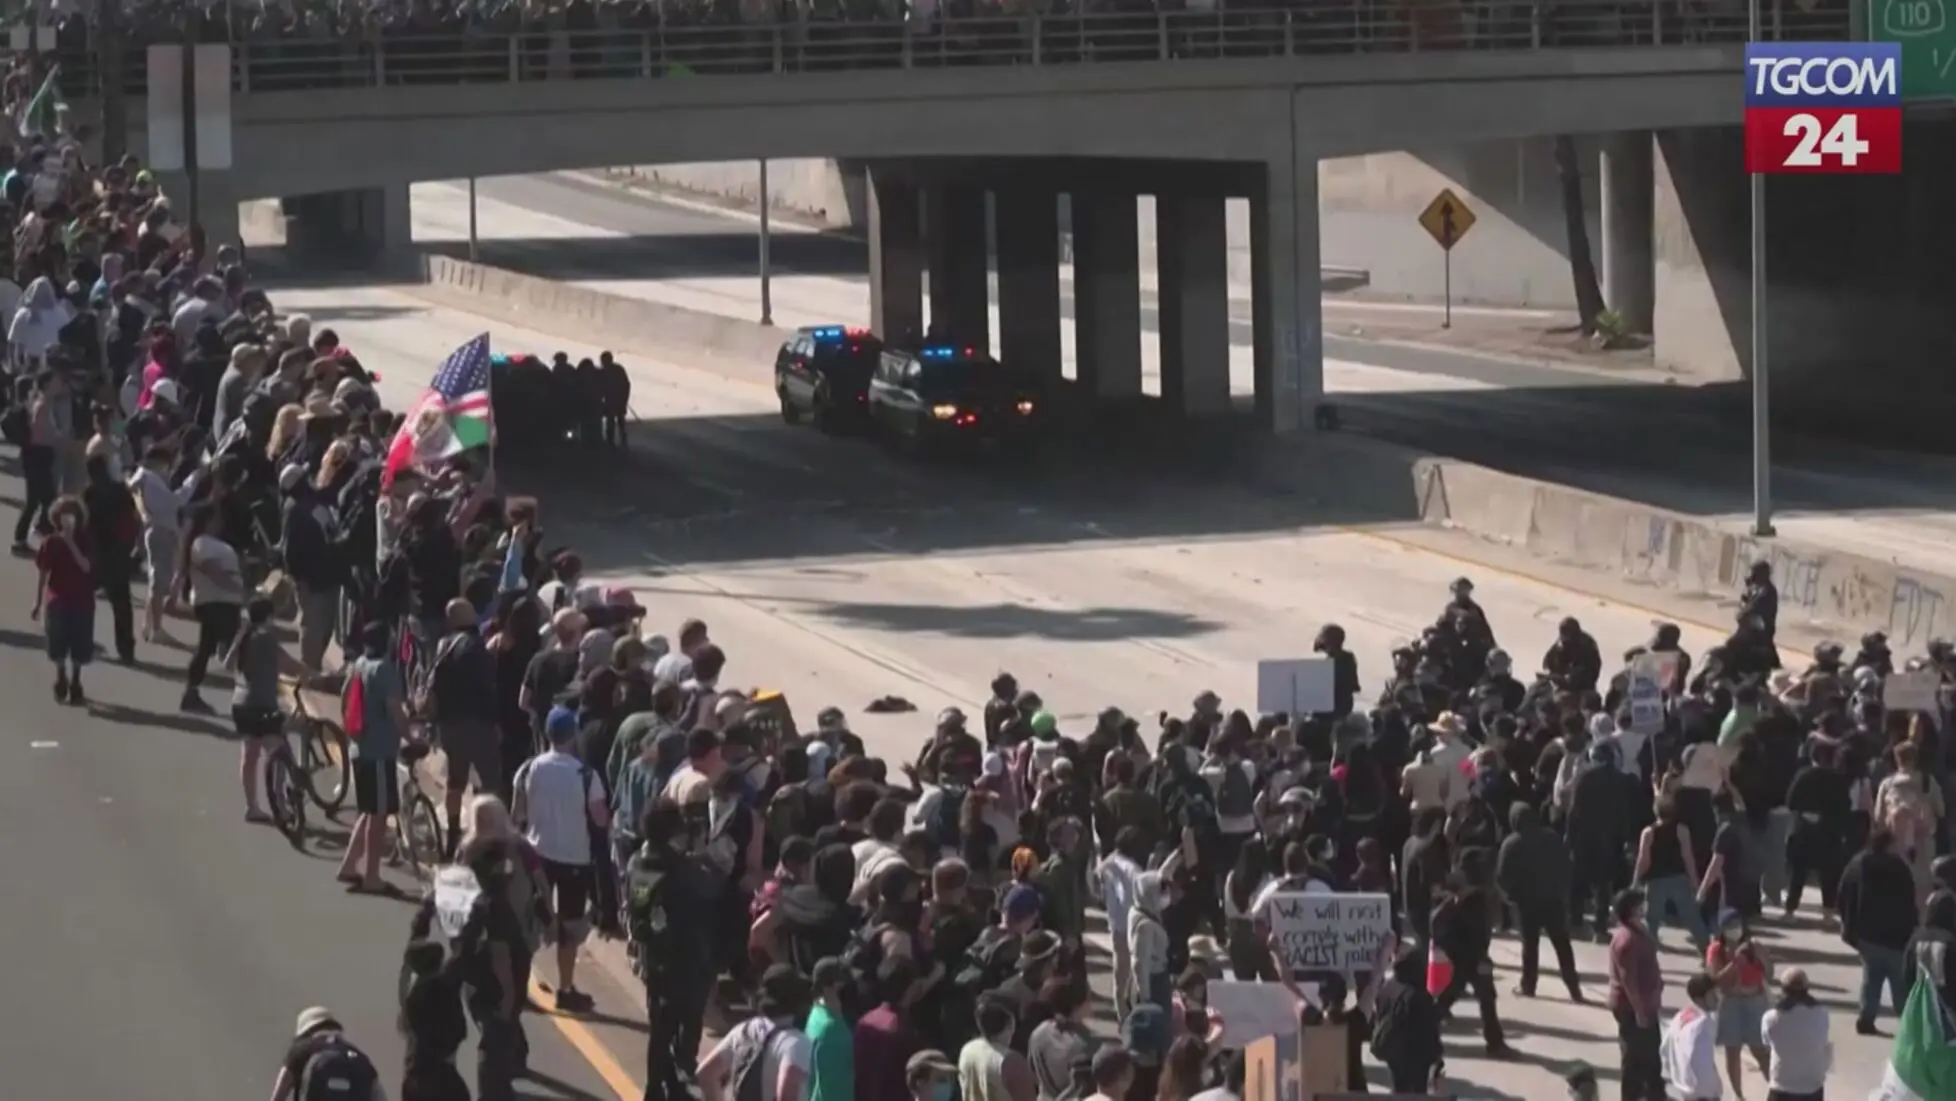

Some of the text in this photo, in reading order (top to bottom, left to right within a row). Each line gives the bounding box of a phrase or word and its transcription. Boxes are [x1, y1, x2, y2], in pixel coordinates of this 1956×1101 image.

[1900, 1, 1931, 27] 110
[1273, 898, 1382, 920] We will not
[1282, 924, 1380, 949] comply with
